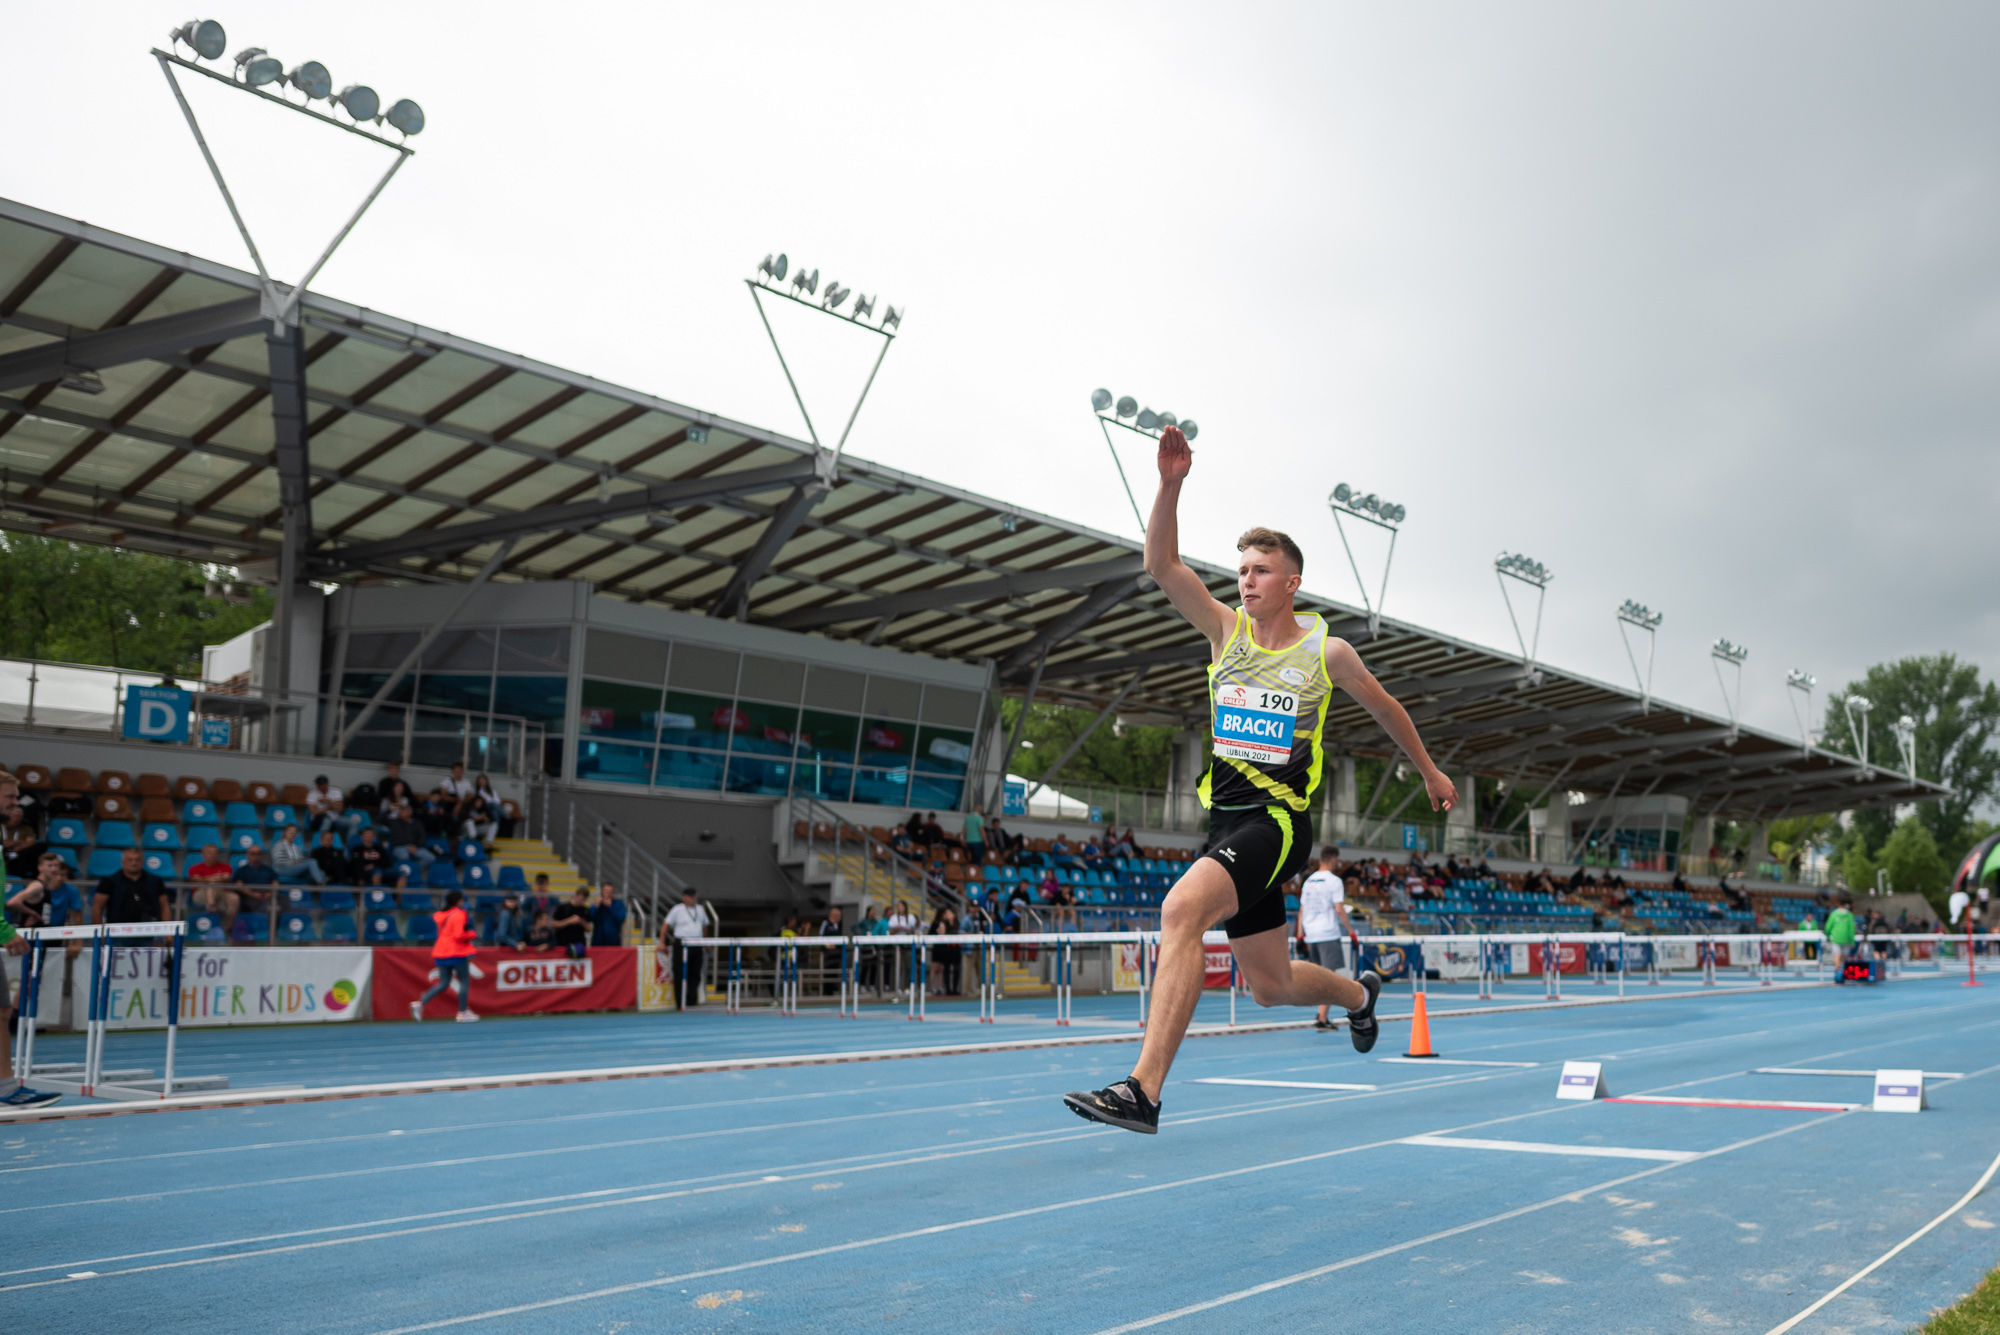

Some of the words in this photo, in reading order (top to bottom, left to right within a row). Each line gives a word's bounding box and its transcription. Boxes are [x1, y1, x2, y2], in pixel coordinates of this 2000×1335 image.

[139, 689, 179, 700] SEKTOR
[1224, 697, 1245, 706] ORLEN
[1260, 693, 1293, 711] 190
[139, 700, 177, 736] D
[1222, 714, 1284, 739] BRACKI
[204, 722, 228, 735] WC
[1226, 748, 1250, 758] LUBLIN
[1252, 752, 1271, 761] 2021
[197, 952, 228, 978] for
[1205, 955, 1231, 968] ORLE
[503, 963, 585, 985] ORLEN
[109, 985, 246, 1021] EALHIER
[259, 983, 316, 1014] KIDS
